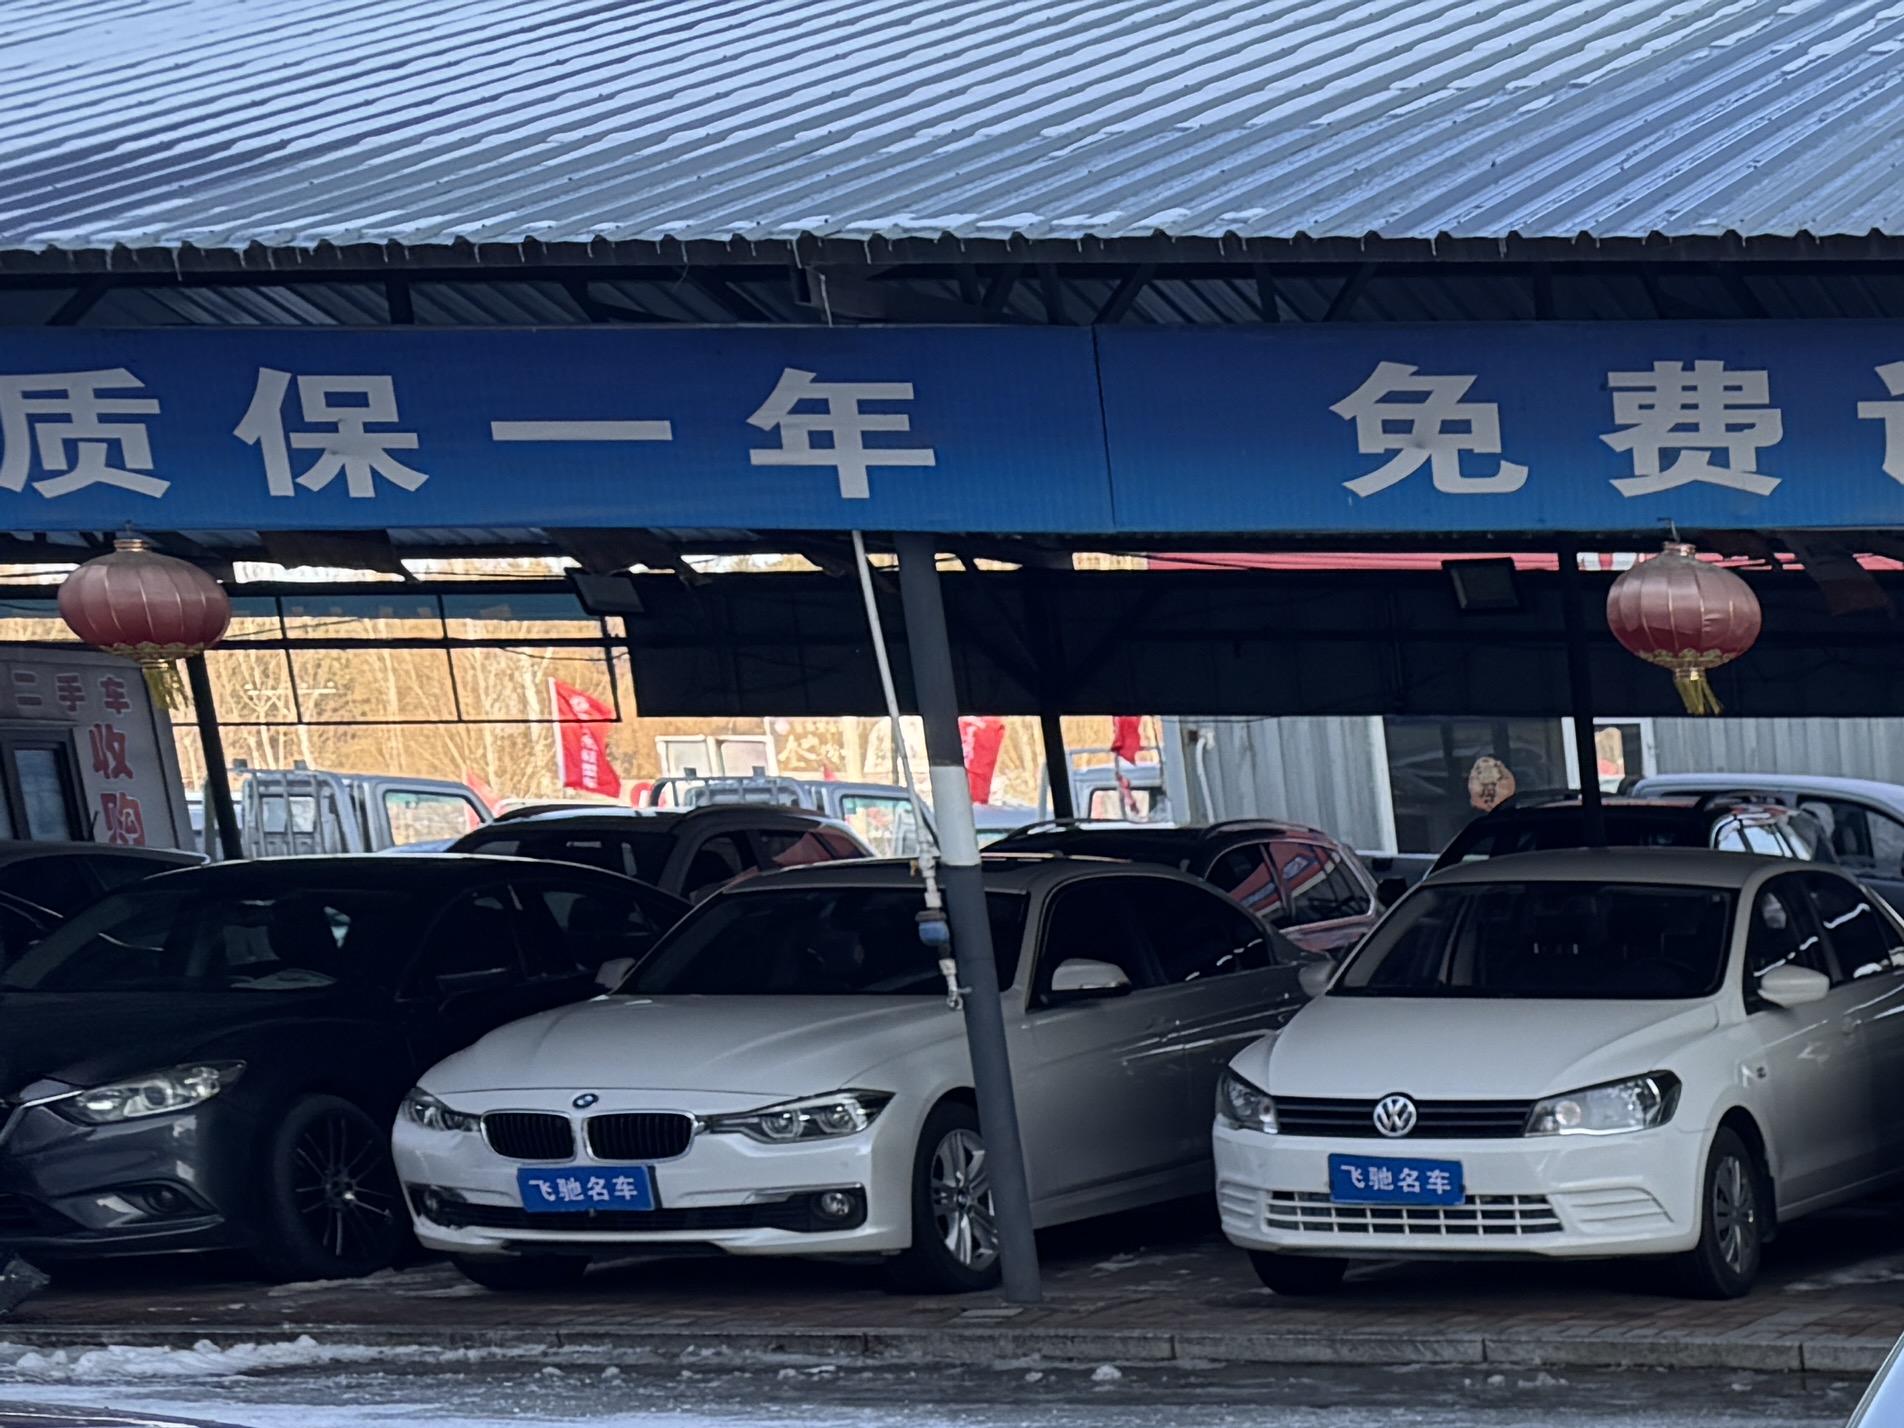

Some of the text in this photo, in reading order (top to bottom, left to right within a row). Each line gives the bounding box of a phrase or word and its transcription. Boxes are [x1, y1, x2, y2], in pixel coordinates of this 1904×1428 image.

[0, 367, 936, 500] 质保一年
[12, 670, 132, 717] 二手车
[88, 723, 146, 846] 收购
[528, 1175, 638, 1202] 飞驰名车
[1340, 1165, 1451, 1195] 飞驰名车
